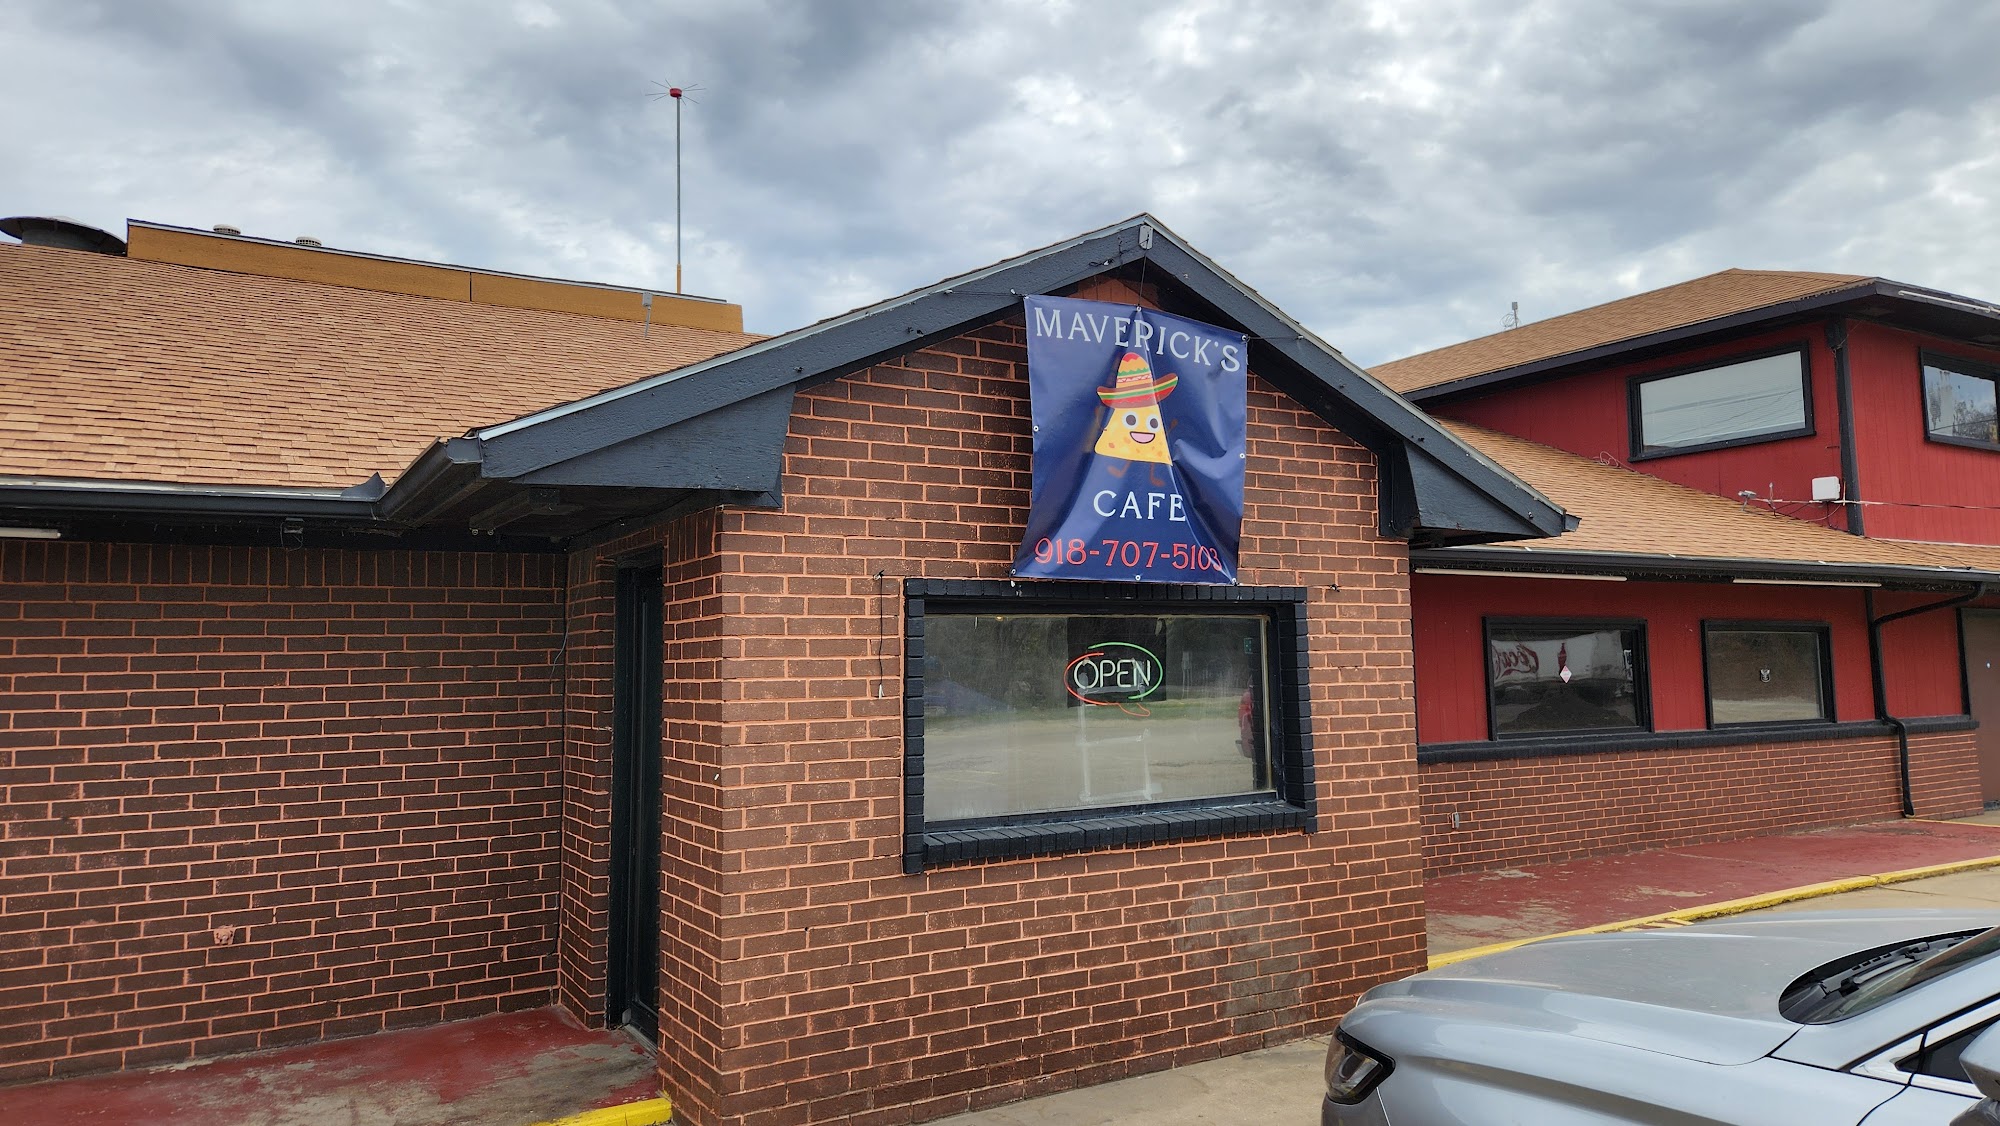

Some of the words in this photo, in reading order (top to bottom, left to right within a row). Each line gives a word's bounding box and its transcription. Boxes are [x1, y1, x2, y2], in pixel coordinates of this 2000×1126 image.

[1034, 307, 1240, 372] MAVERICK'S
[1093, 490, 1186, 521] CAFE
[1034, 537, 1222, 571] 918-707-5103
[1074, 659, 1151, 689] OPEN
